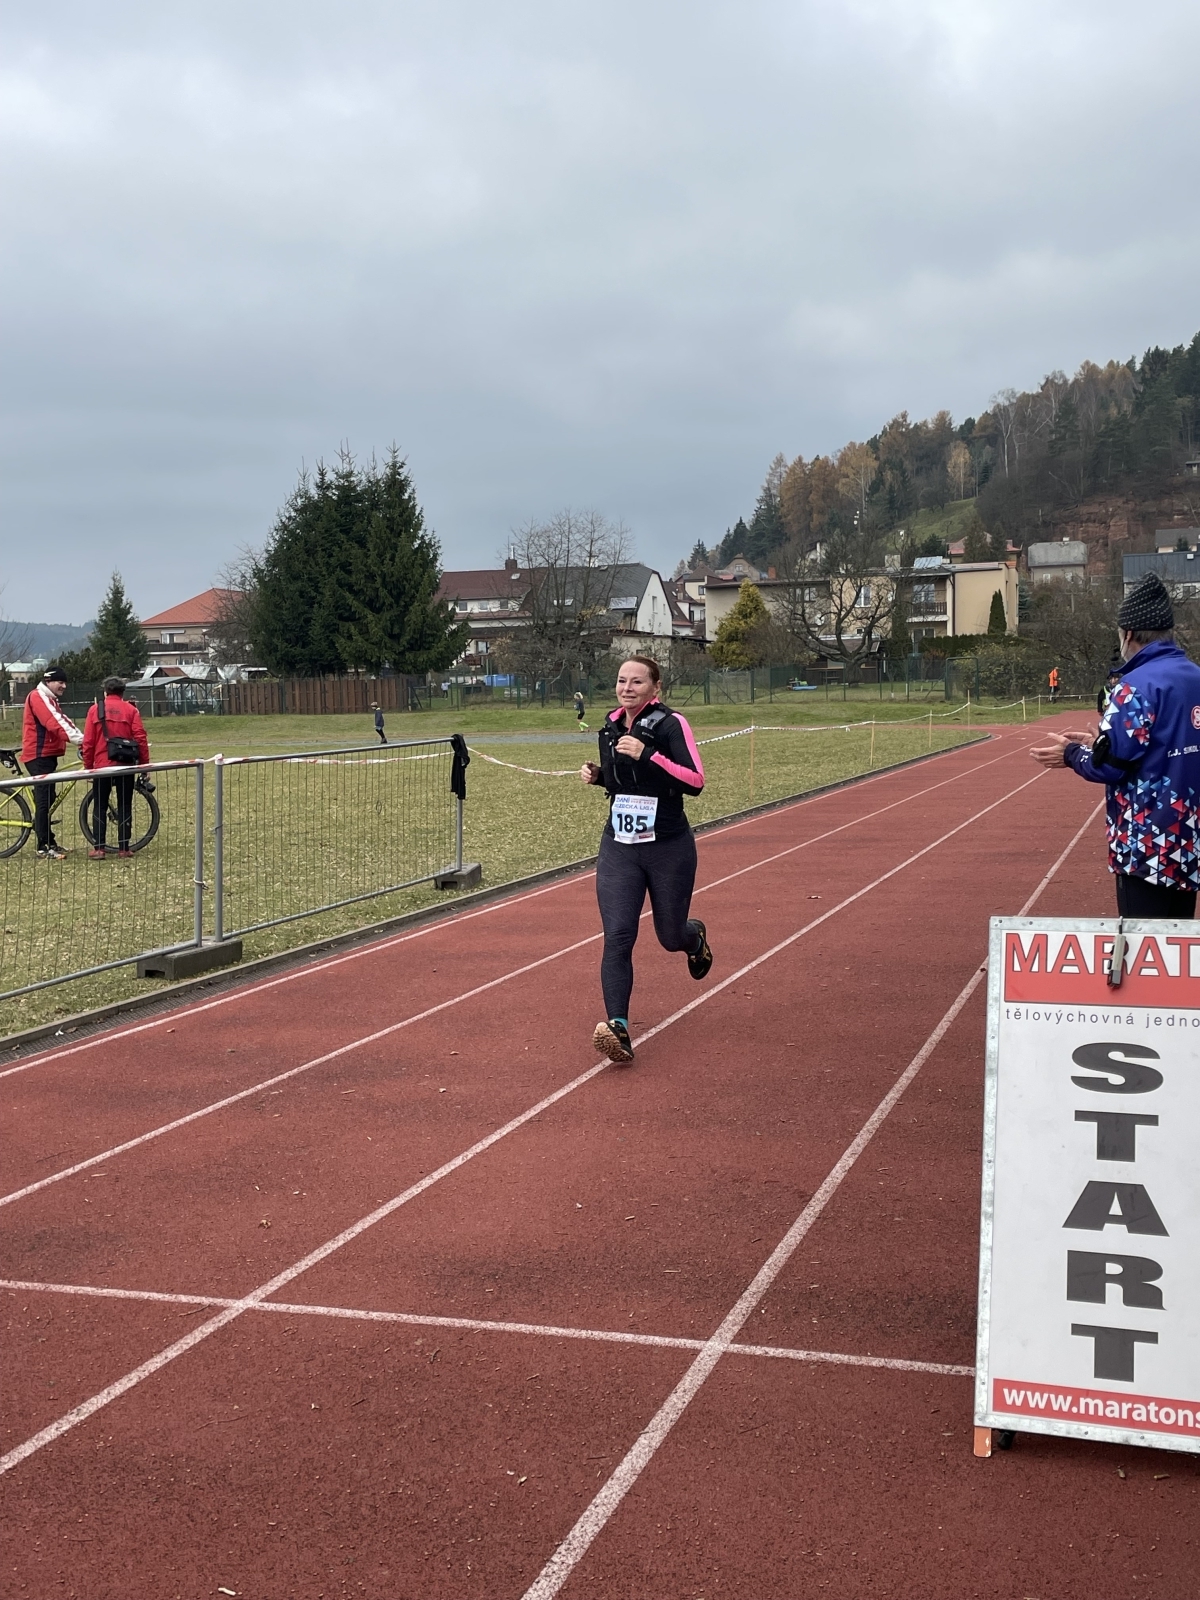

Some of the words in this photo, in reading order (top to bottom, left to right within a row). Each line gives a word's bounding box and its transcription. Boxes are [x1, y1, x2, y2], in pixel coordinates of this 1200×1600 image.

[617, 813, 648, 833] 185
[1006, 1008, 1135, 1025] tělovýchovná
[1062, 1042, 1170, 1382] START
